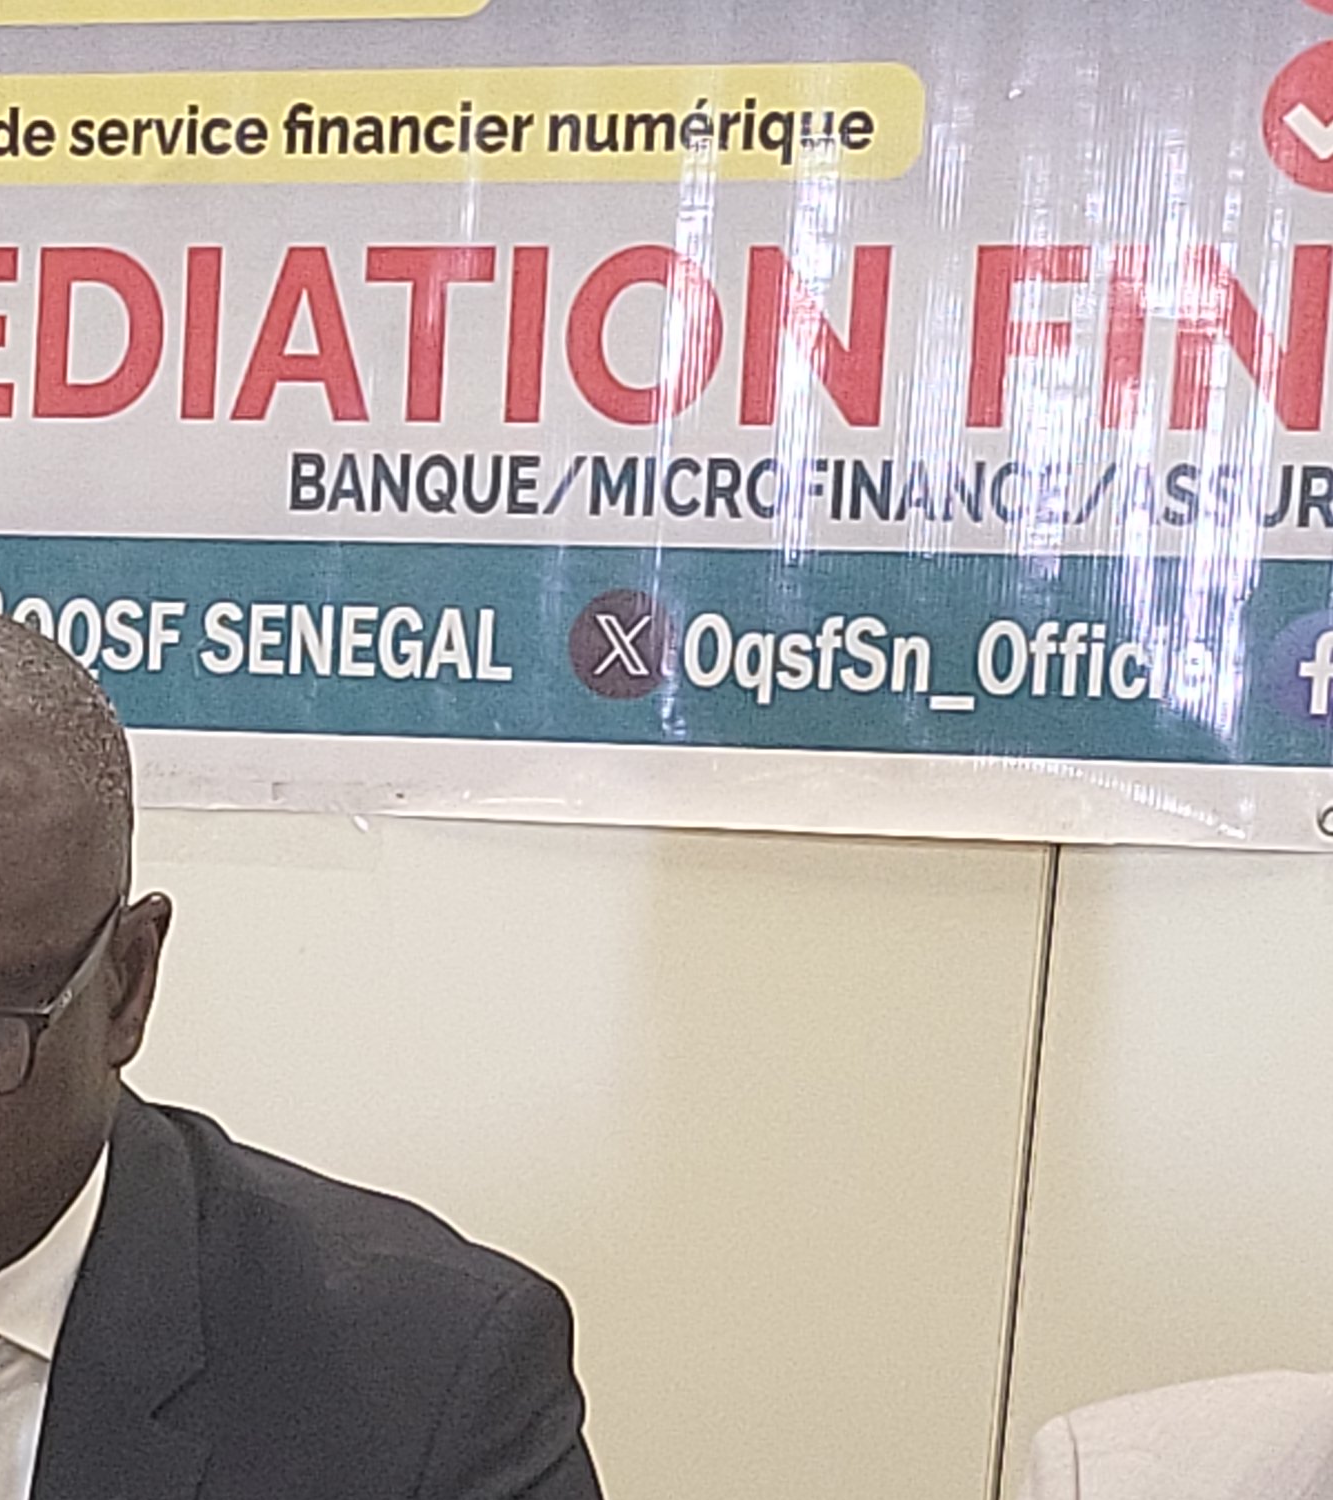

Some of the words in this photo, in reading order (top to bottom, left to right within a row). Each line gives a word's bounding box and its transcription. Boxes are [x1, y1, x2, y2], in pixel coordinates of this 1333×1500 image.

[67, 104, 268, 158] service
[283, 100, 534, 155] financier
[547, 98, 876, 165] numérique
[964, 243, 1333, 431] FIN
[199, 602, 514, 682] SENEGAL
